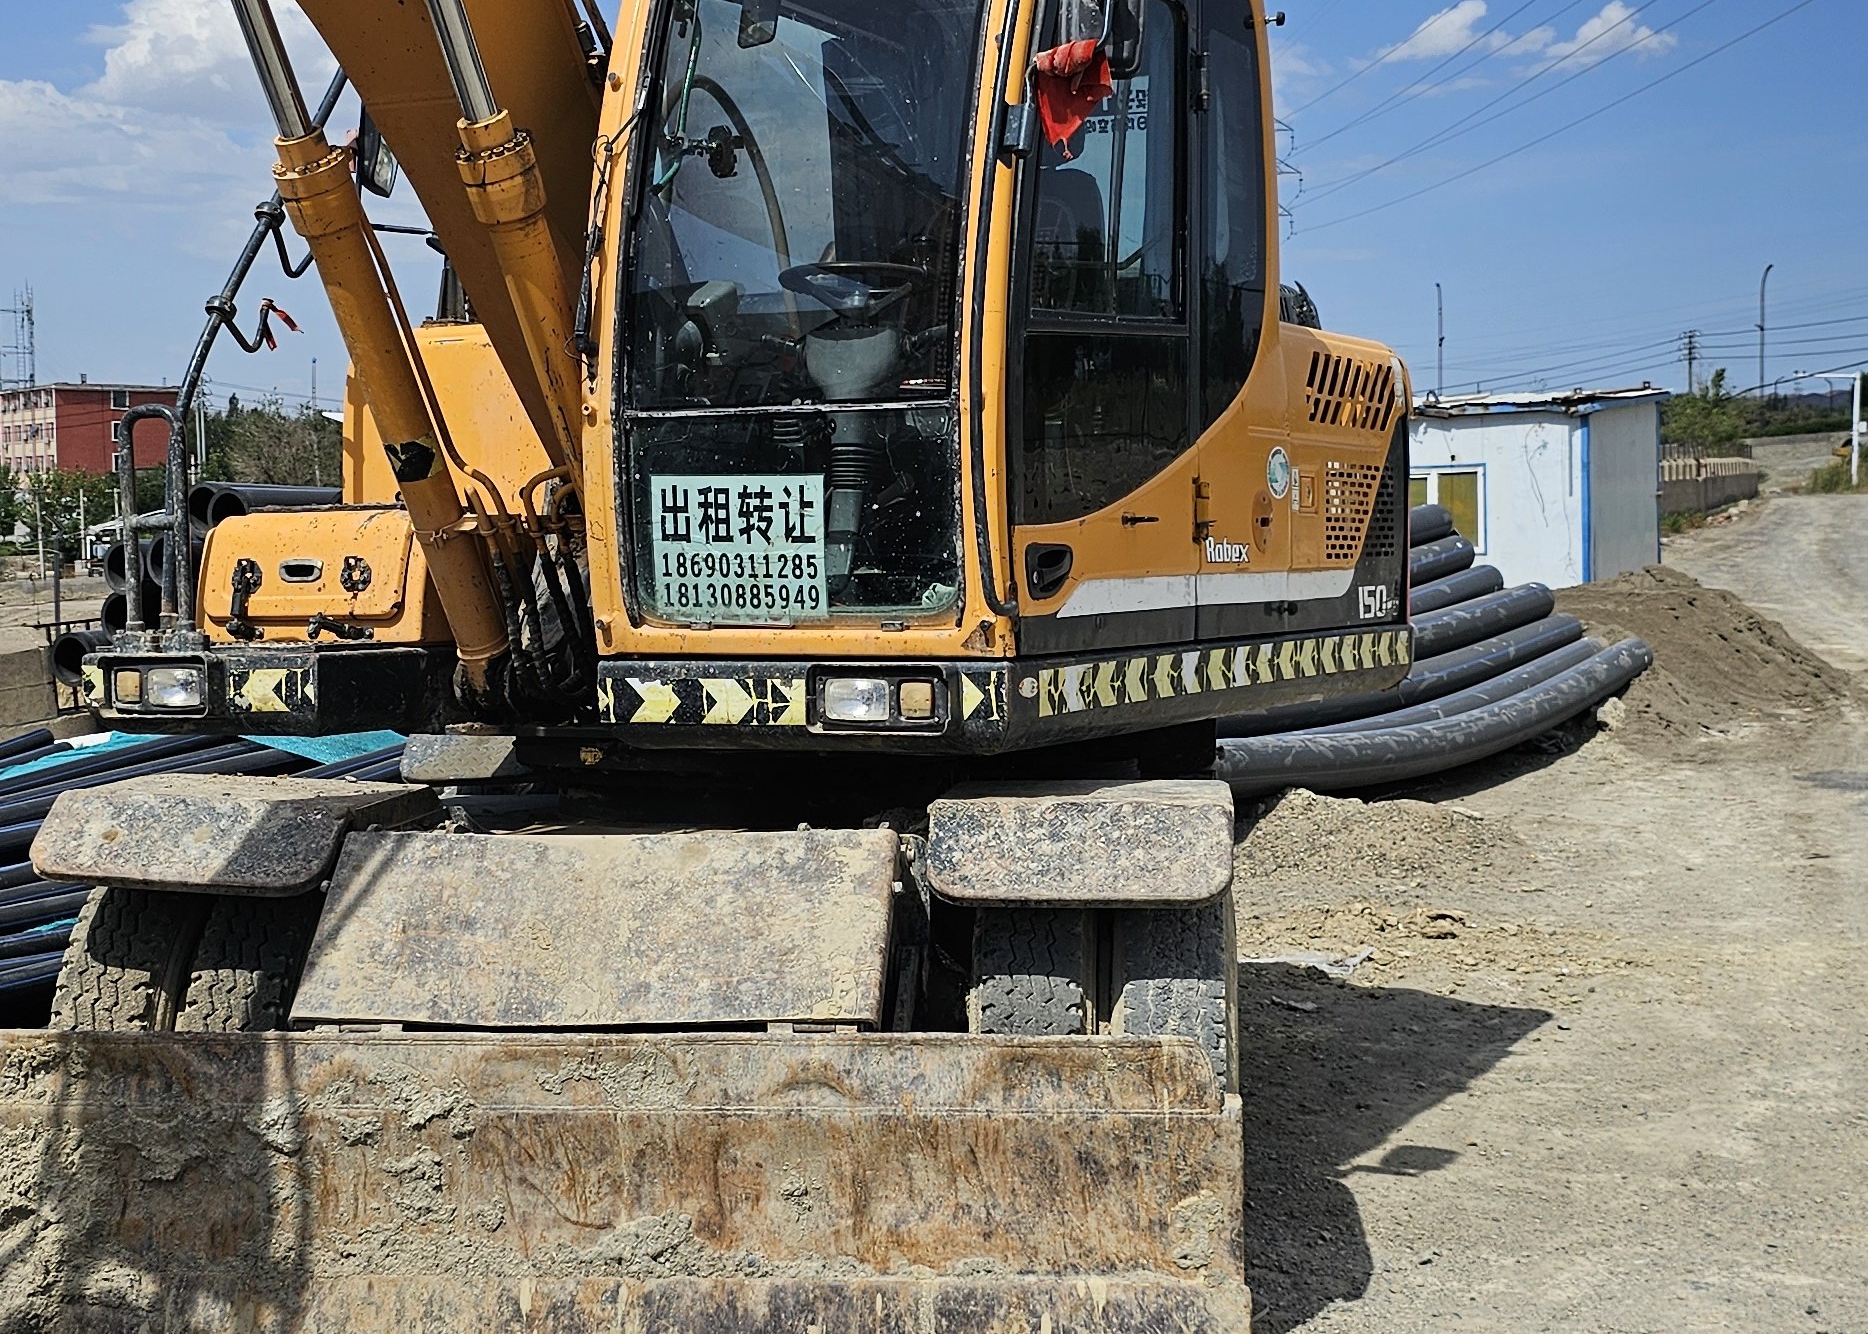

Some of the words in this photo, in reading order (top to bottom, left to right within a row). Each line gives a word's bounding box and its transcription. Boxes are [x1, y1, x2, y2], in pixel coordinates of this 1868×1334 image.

[660, 484, 817, 545] 出租转让
[1205, 536, 1250, 563] Robex
[662, 552, 819, 580] 18690311285
[664, 582, 820, 611] 18130885949
